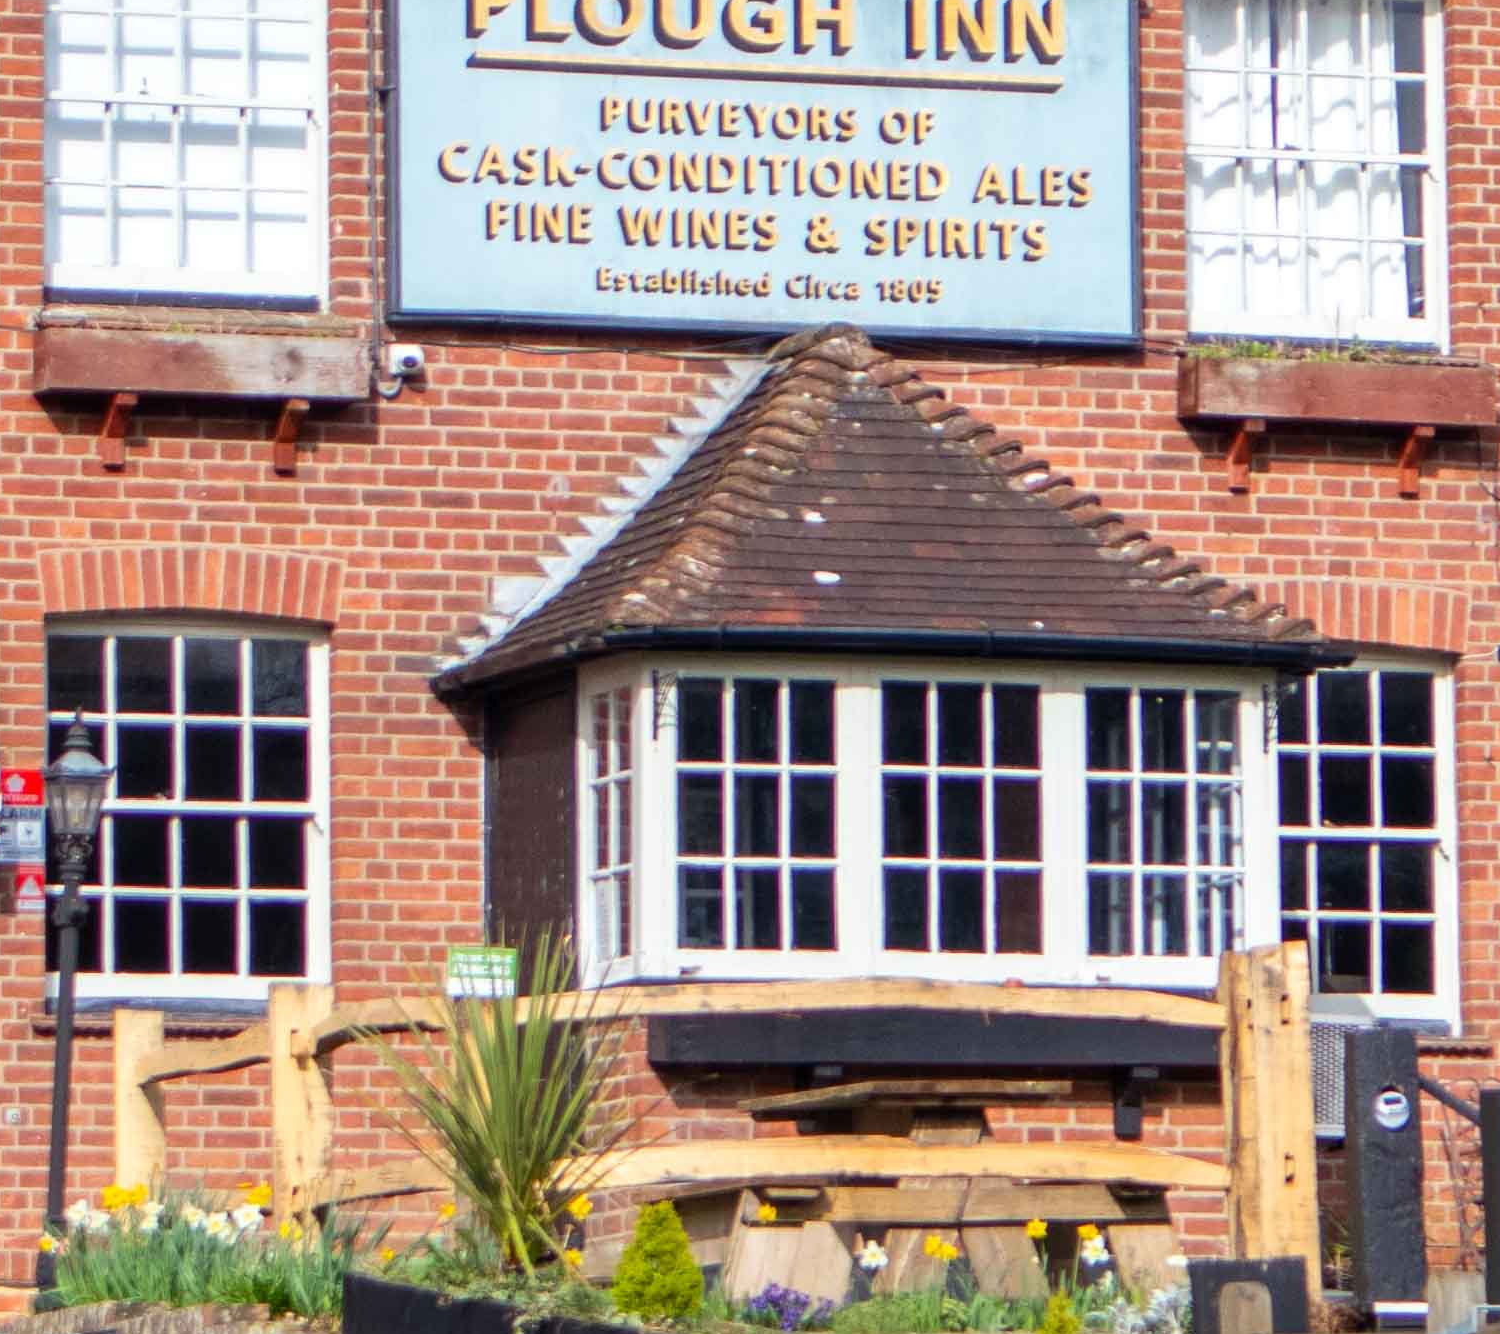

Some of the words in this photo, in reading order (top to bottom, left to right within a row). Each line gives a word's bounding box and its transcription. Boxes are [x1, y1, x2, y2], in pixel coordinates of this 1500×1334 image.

[600, 96, 859, 143] PURVEYORS
[880, 107, 936, 145] OF
[438, 141, 949, 202] CASK-CONDITIONED
[972, 161, 1094, 208] ALES
[485, 200, 595, 245] FINE
[617, 203, 781, 252] WINES
[805, 212, 841, 255] &
[864, 214, 1049, 262] SPIRITS
[596, 267, 773, 299] Established
[785, 273, 861, 302] Circa
[877, 277, 946, 304] 1805
